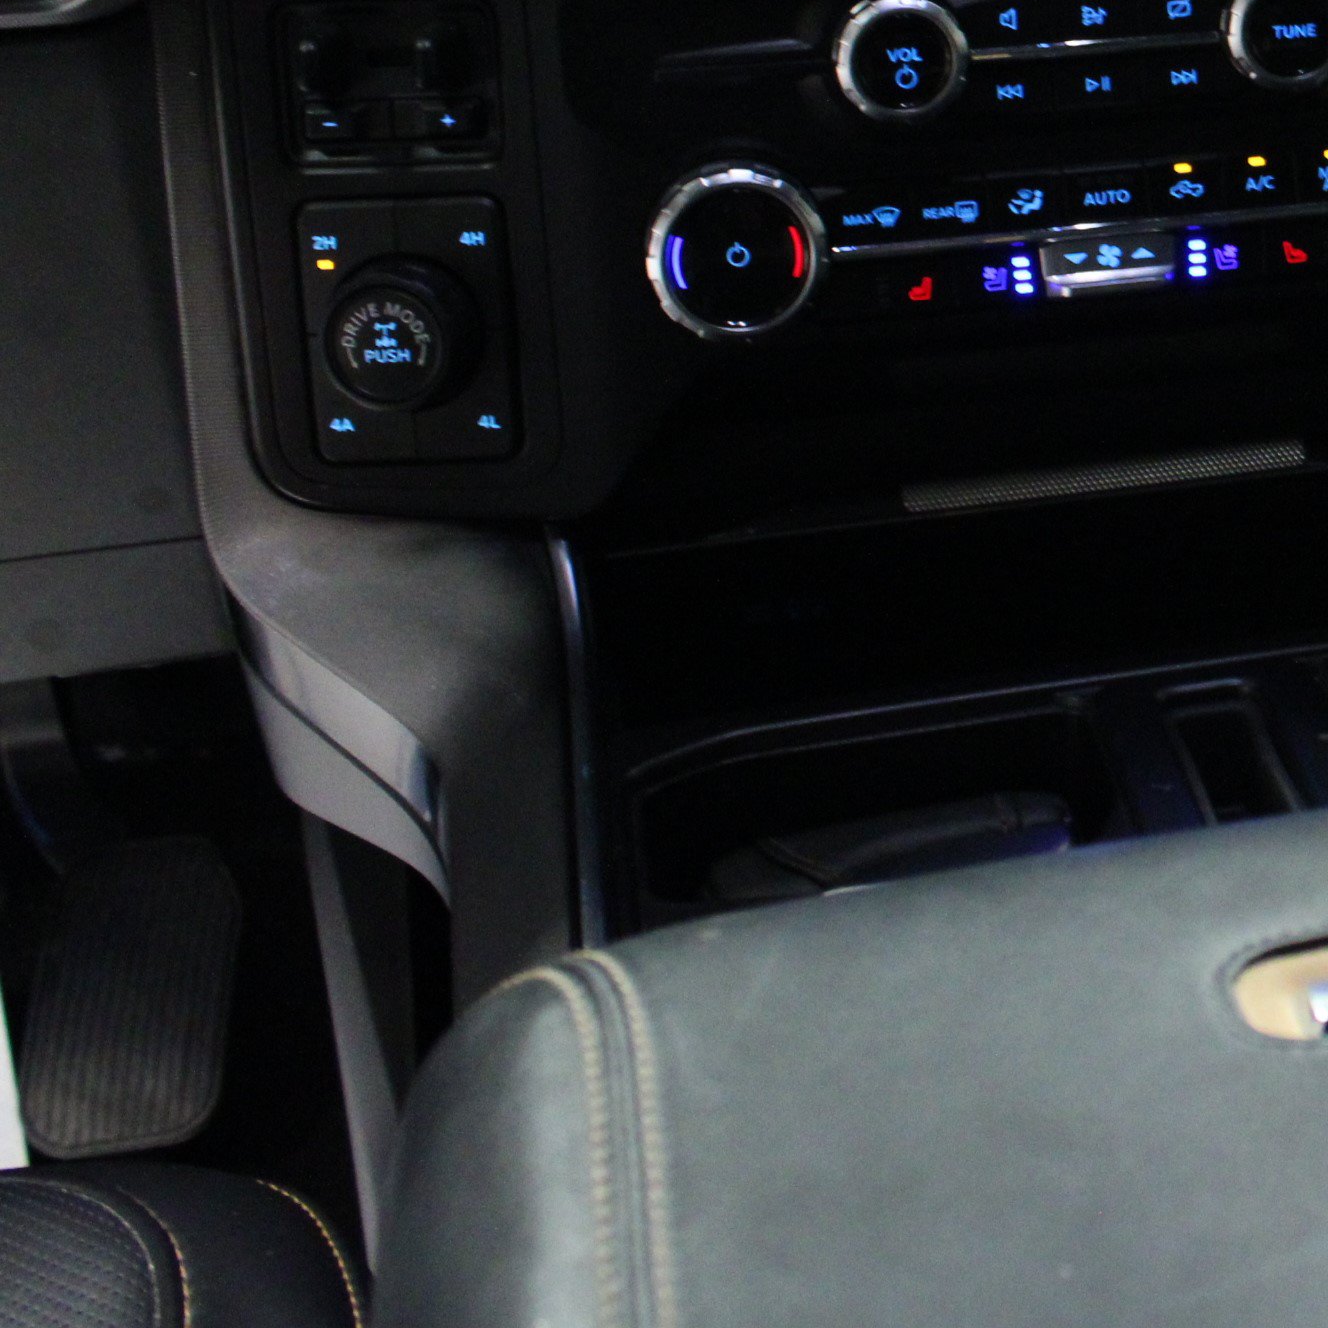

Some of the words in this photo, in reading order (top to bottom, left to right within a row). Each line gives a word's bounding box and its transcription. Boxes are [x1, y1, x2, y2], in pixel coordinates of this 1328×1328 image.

[1272, 23, 1318, 40] TUNE
[886, 47, 923, 63] VOL
[1245, 175, 1275, 192] A/C
[1083, 189, 1131, 206] AUTO
[843, 213, 875, 228] MAX
[923, 206, 955, 220] REAR
[312, 235, 338, 251] 2H
[459, 230, 486, 247] 4H
[341, 302, 380, 348] DRIVE
[384, 301, 432, 345] MODE
[364, 348, 412, 364] PUSH
[329, 417, 356, 433] 4A
[477, 414, 502, 430] 4L
